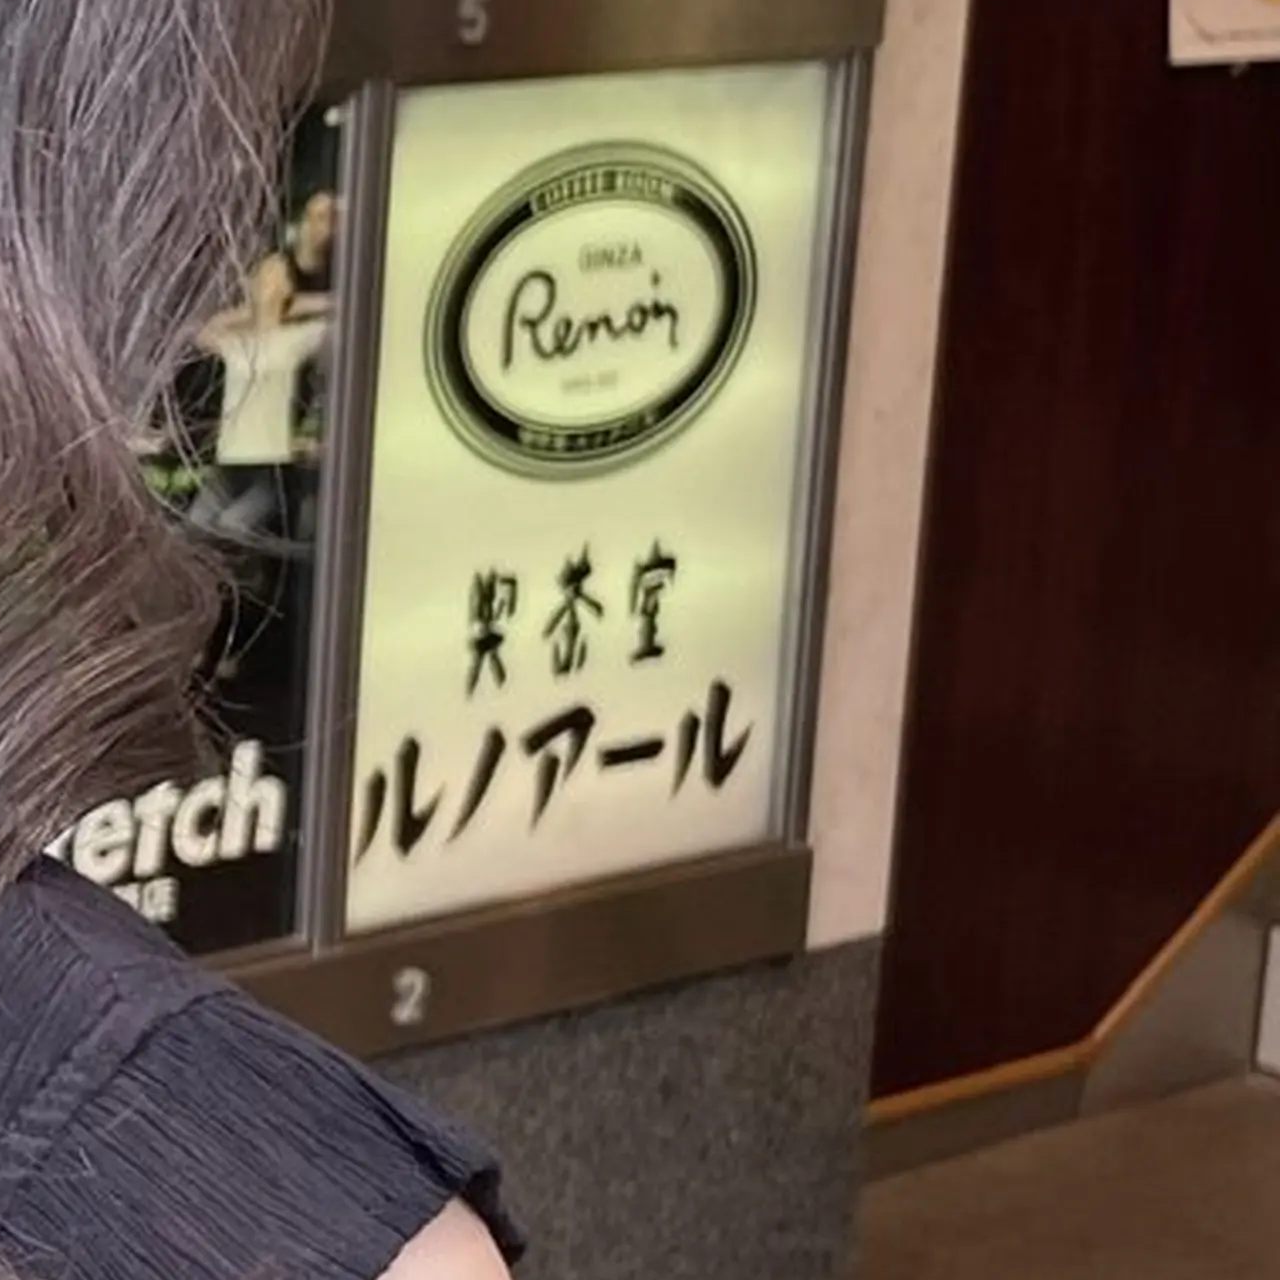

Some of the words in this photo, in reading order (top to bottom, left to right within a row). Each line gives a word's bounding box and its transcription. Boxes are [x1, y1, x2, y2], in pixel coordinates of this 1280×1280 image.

[466, 541, 678, 696] 喫茶室
[43, 738, 287, 886] etch
[354, 680, 752, 868] ルノアール
[390, 965, 430, 1025] 2
